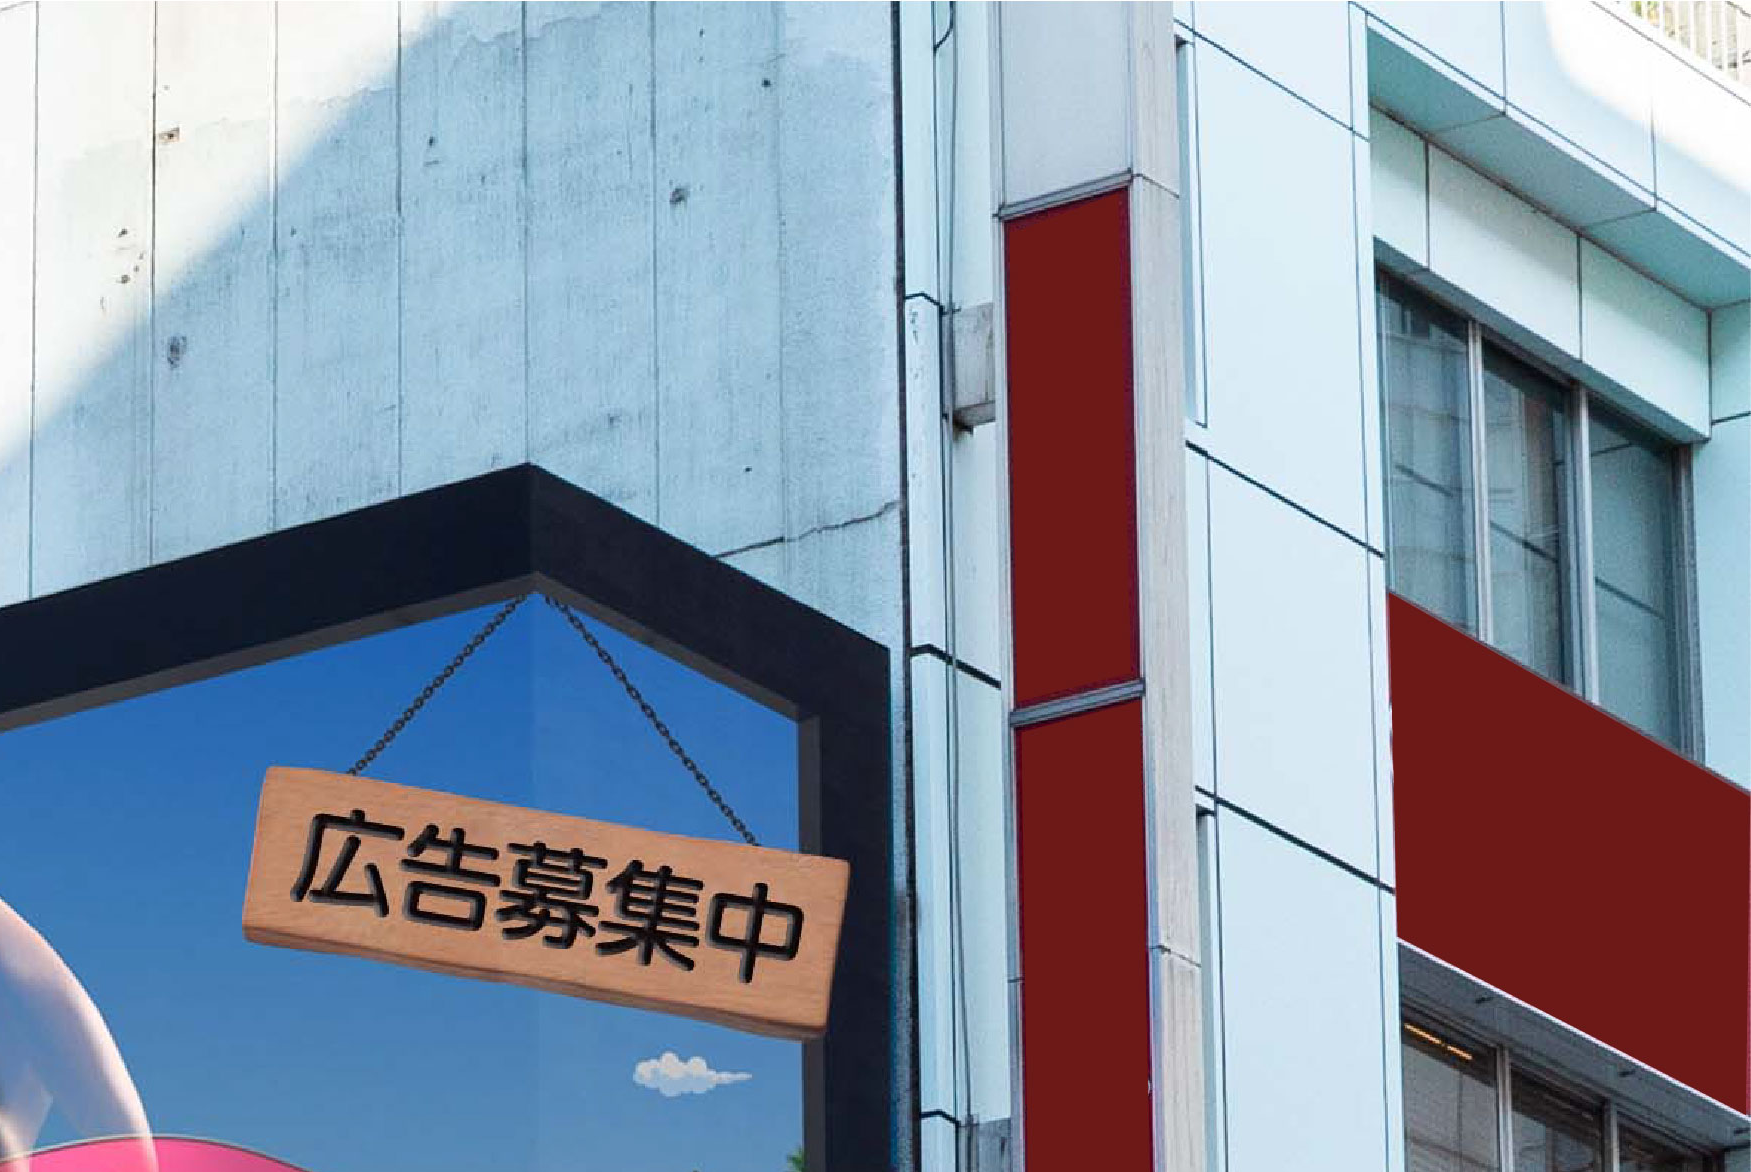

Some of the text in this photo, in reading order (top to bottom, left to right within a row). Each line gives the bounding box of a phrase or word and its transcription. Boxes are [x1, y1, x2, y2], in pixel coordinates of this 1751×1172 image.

[289, 809, 805, 984] 広告募集中
